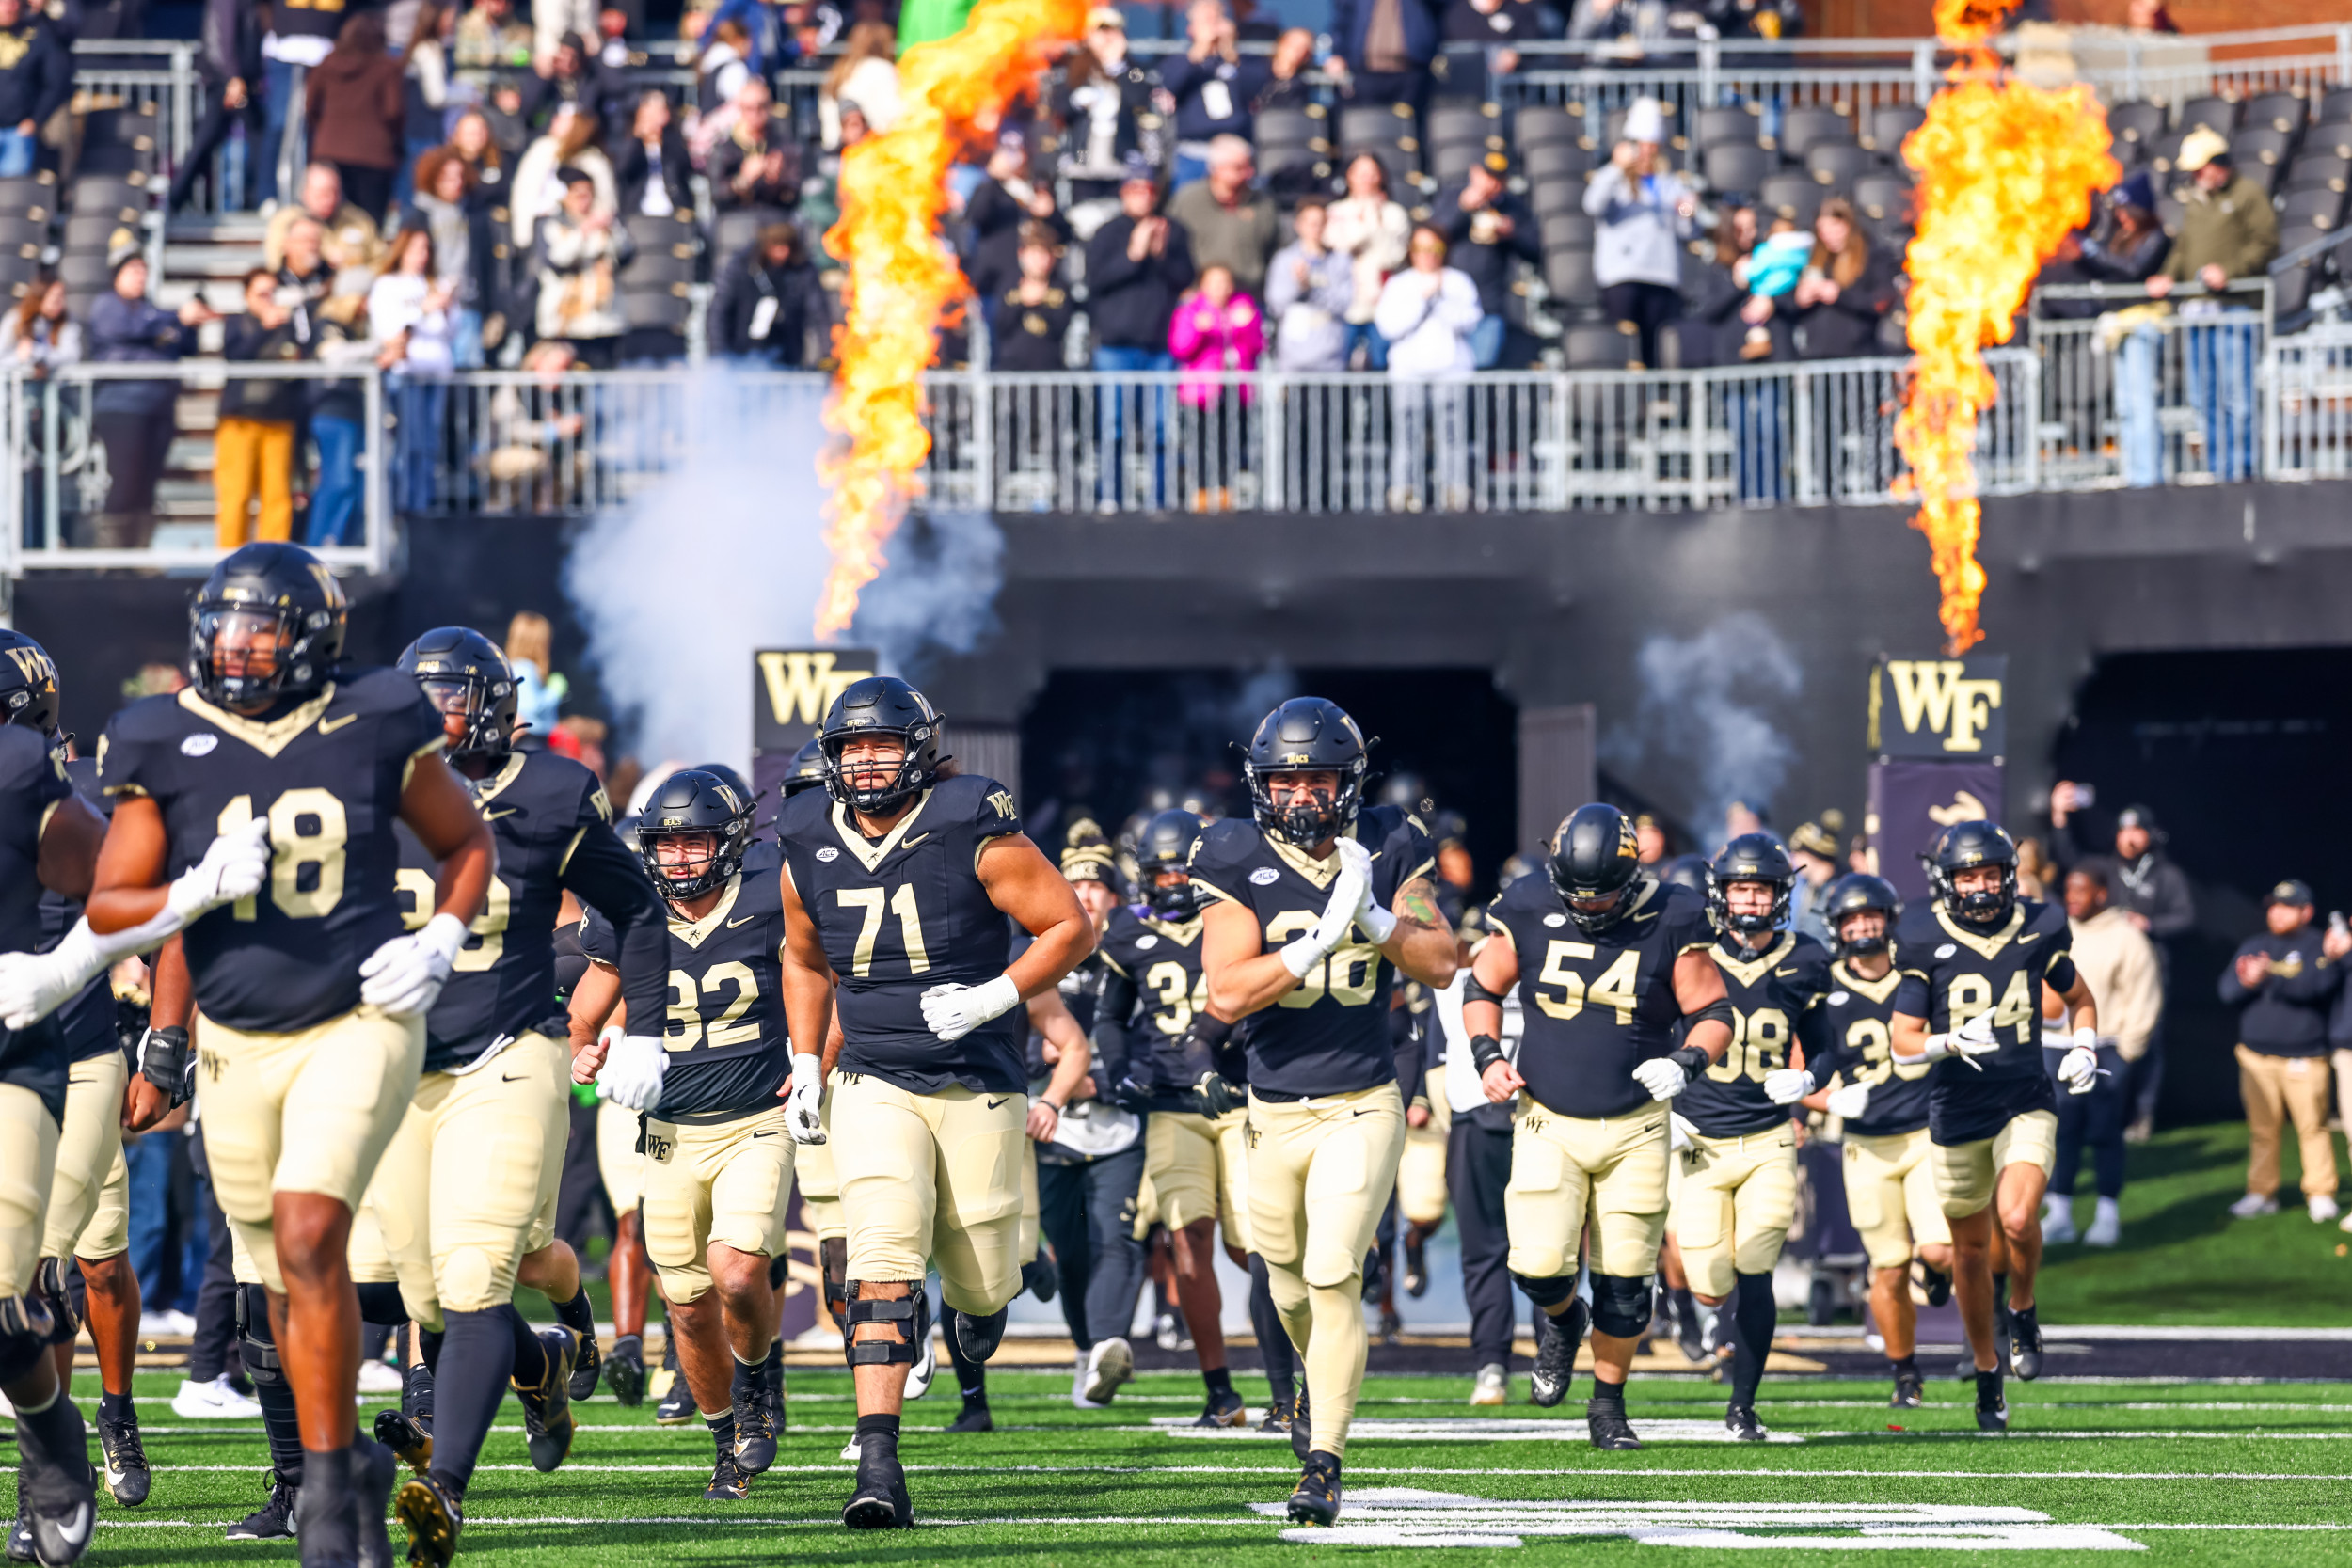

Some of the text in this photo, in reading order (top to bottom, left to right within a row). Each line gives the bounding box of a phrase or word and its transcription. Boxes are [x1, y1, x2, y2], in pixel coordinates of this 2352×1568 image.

[1888, 660, 2002, 752] WF
[837, 882, 930, 978] 71
[1534, 939, 1641, 1025] 54
[1947, 968, 2033, 1045] 84
[648, 1134, 672, 1161] WF
[1525, 1115, 1550, 1134] WF
